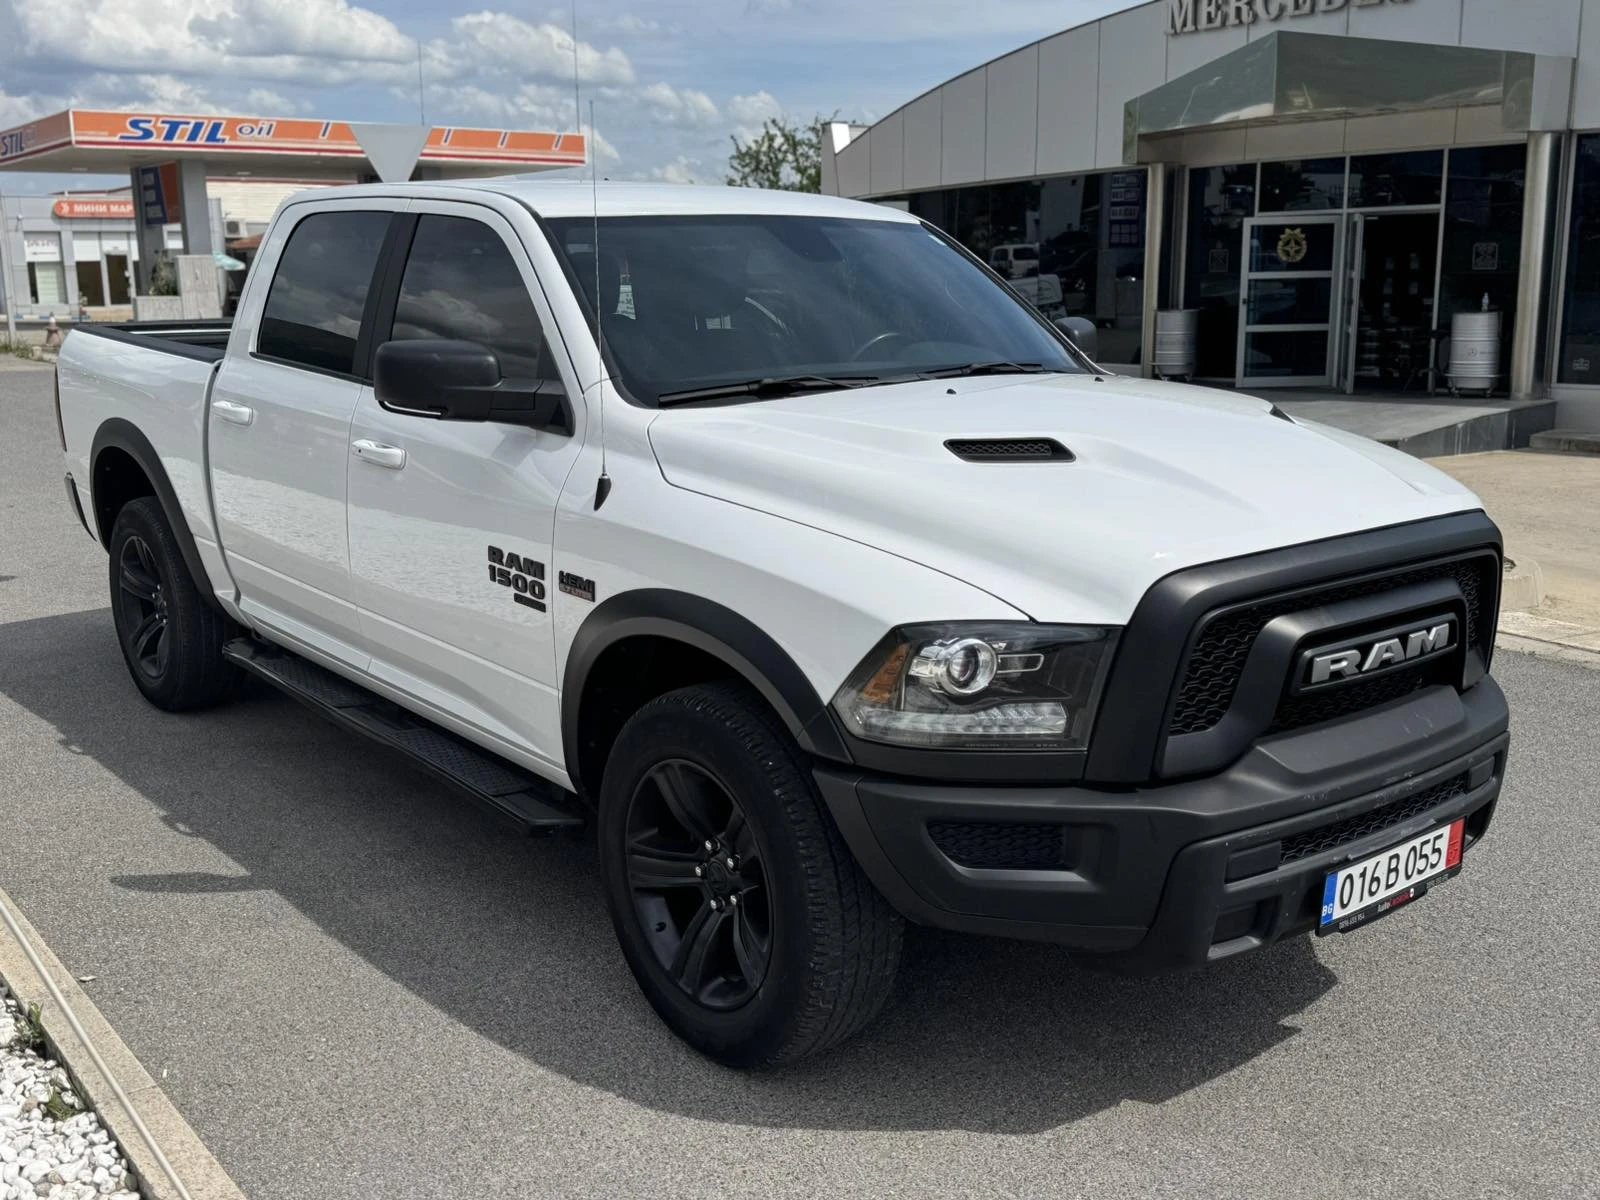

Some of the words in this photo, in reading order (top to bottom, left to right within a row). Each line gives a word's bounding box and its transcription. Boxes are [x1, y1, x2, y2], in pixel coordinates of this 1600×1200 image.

[0, 130, 25, 157] STIL
[118, 117, 229, 144] STIL
[238, 121, 275, 137] oil
[110, 203, 134, 213] МАР
[488, 545, 545, 580] RAM
[488, 564, 546, 600] 1500
[559, 570, 595, 595] HEMI
[1311, 623, 1449, 684] RAM
[1321, 903, 1333, 916] BG
